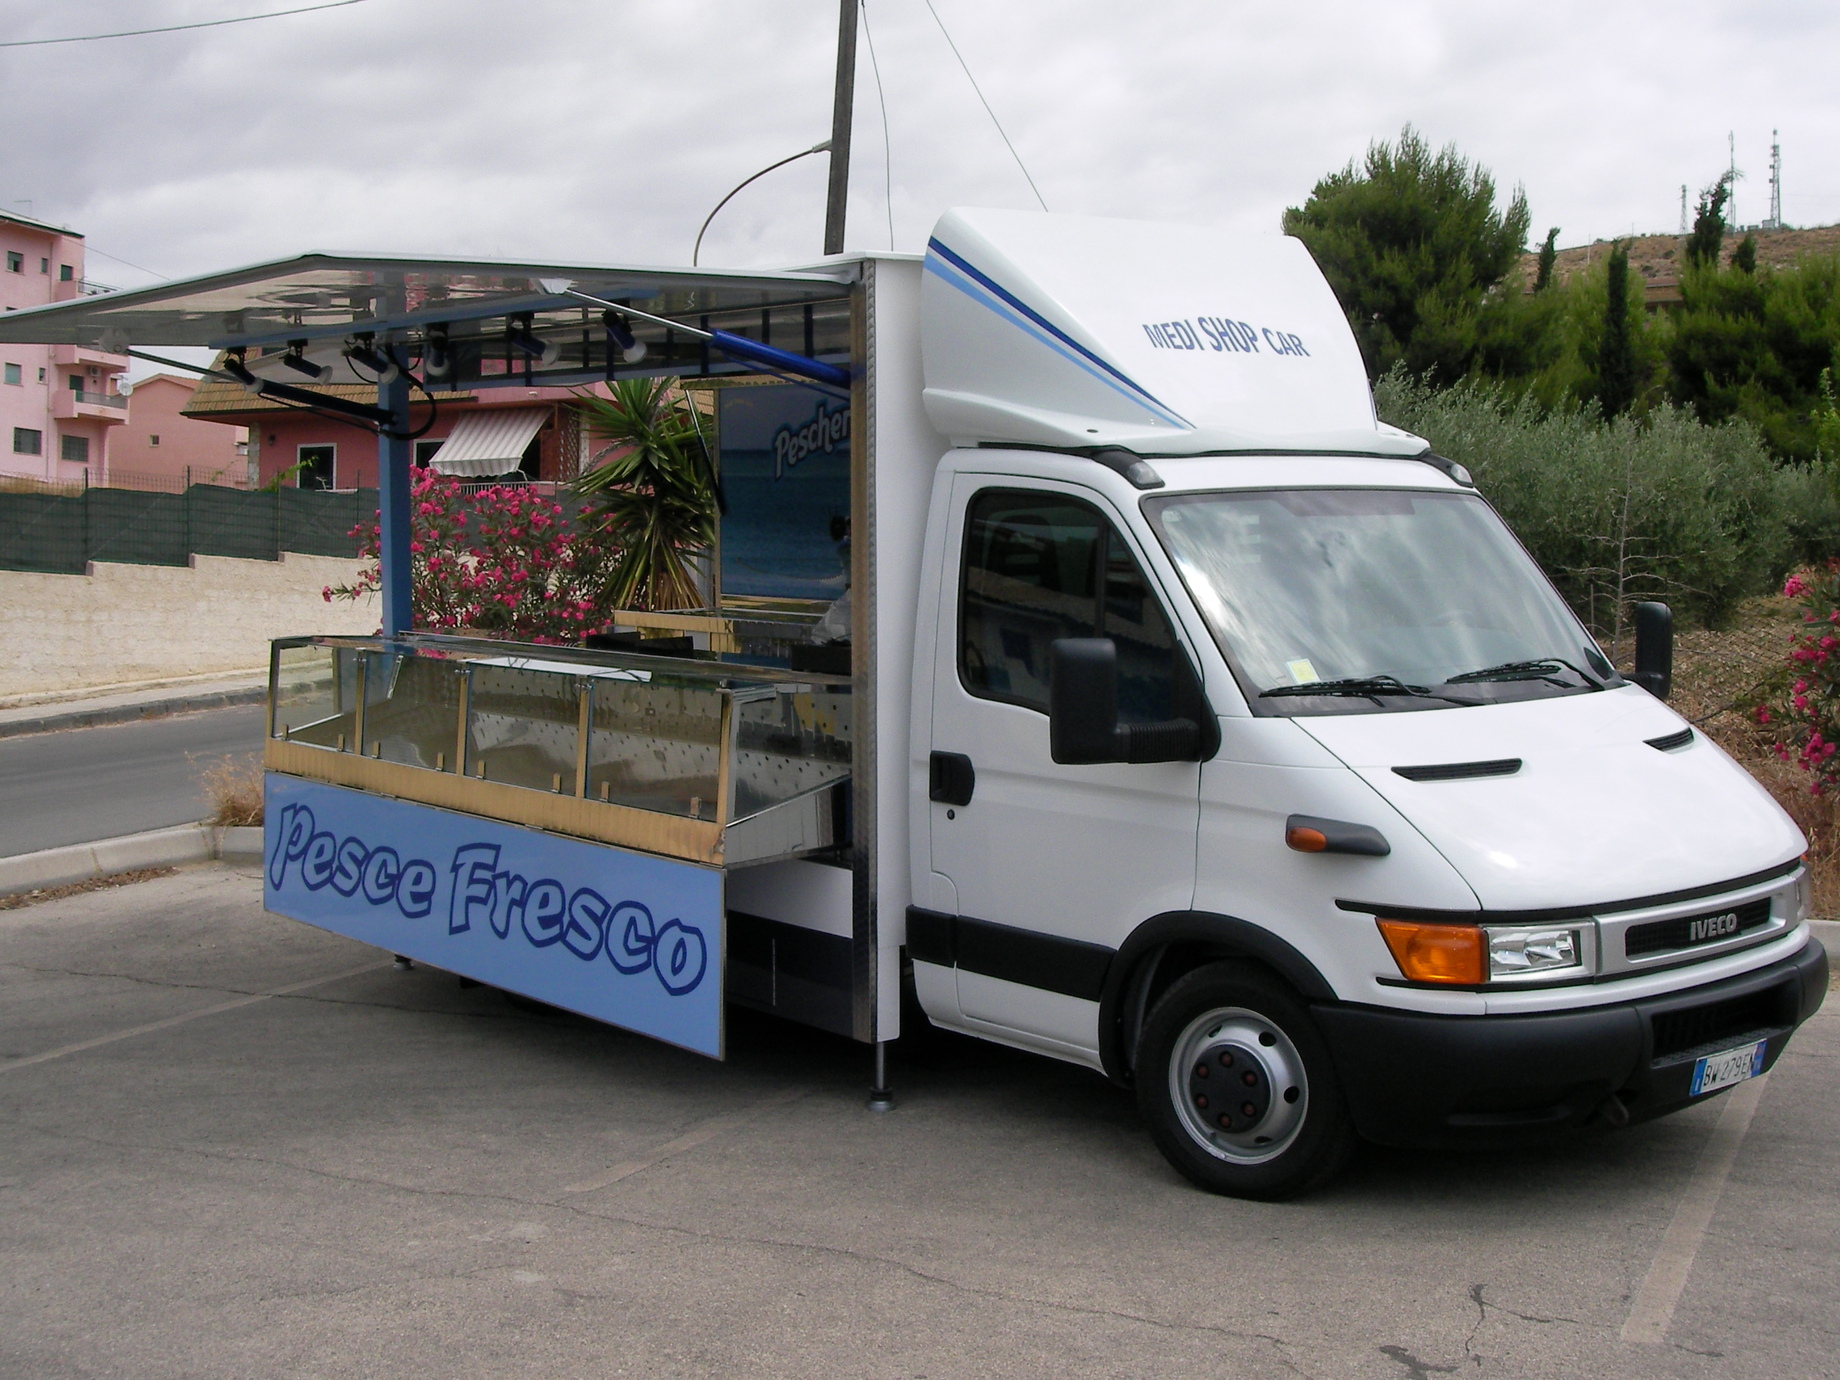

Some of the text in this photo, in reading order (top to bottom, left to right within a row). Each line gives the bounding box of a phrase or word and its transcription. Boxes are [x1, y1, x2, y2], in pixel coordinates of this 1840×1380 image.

[1142, 316, 1312, 357] MEDI SHOP CAR
[269, 802, 708, 997] Pesce Fresco
[1690, 912, 1738, 941] IVECO
